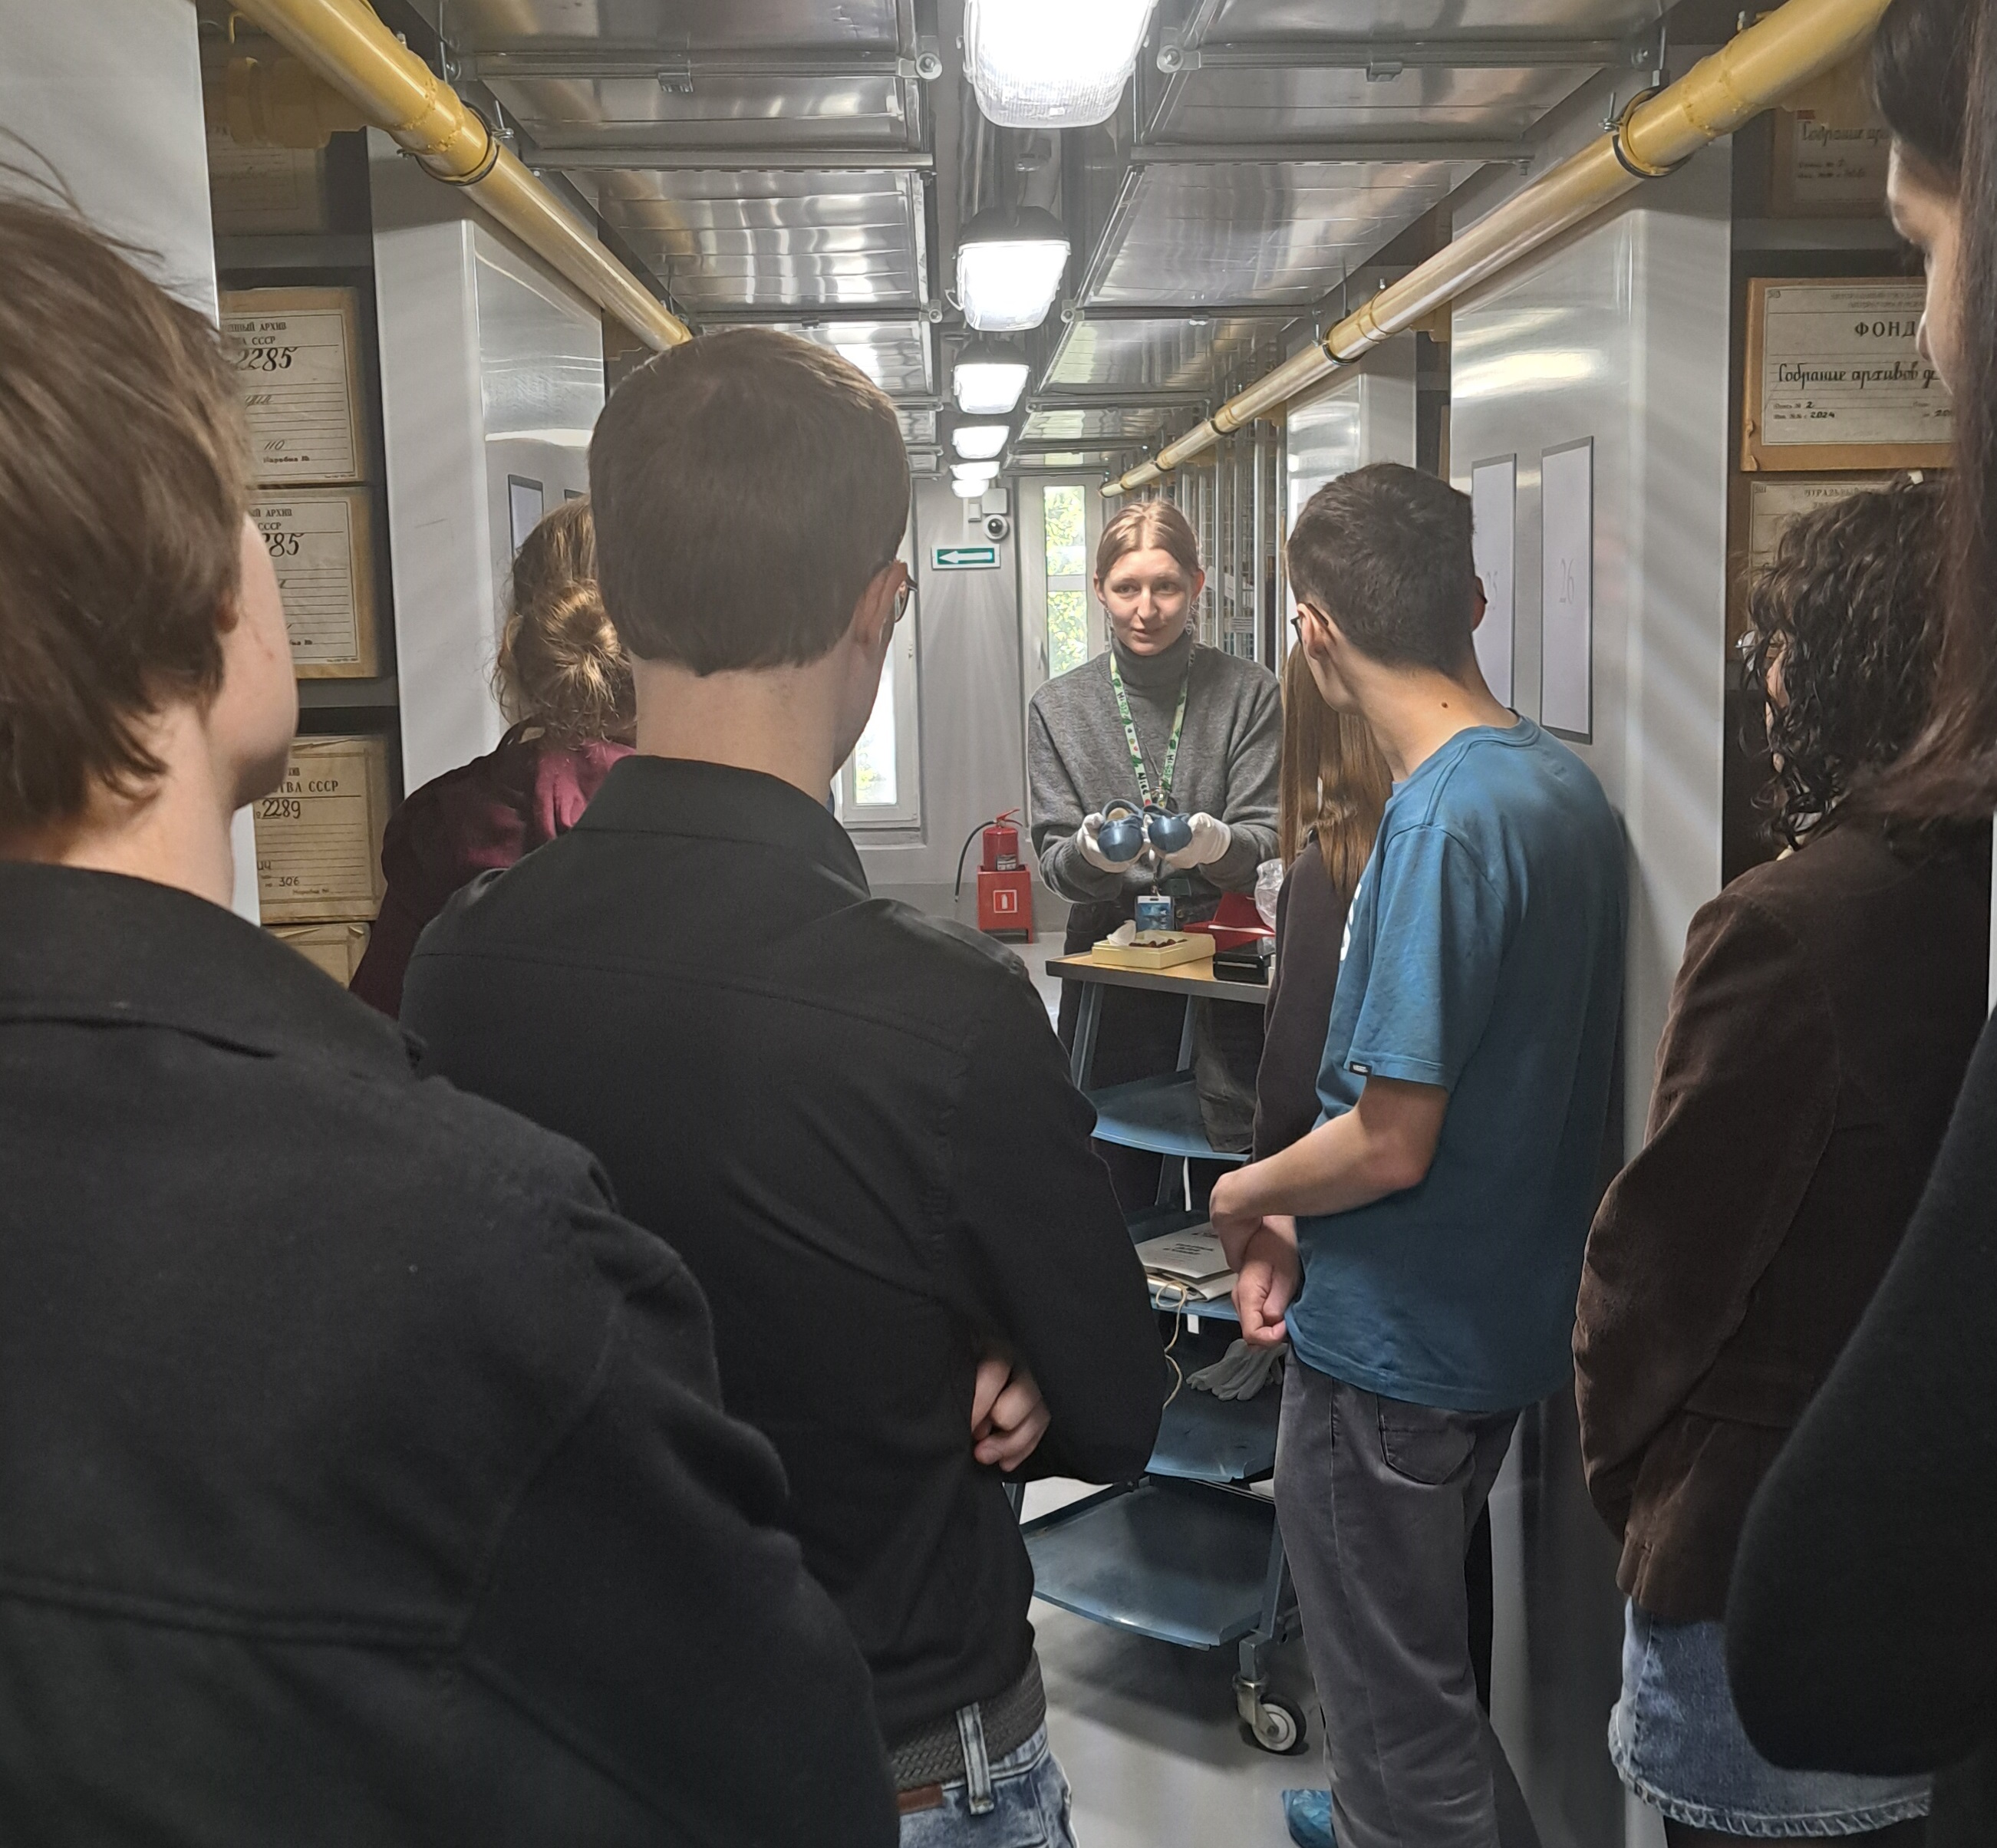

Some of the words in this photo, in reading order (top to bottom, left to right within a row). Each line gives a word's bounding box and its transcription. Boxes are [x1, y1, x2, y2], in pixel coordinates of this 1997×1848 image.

[259, 321, 287, 332] АРХИВ
[1854, 321, 1916, 338] ФОНД
[252, 335, 276, 345] СССР
[235, 347, 298, 371] 2285
[1778, 362, 1847, 390] Собрание
[265, 508, 292, 518] АРХИВ
[258, 522, 282, 532] СССР
[1558, 558, 1574, 605] 26
[308, 780, 339, 792] СССР
[262, 798, 301, 819] 2289
[278, 876, 300, 887] 306
